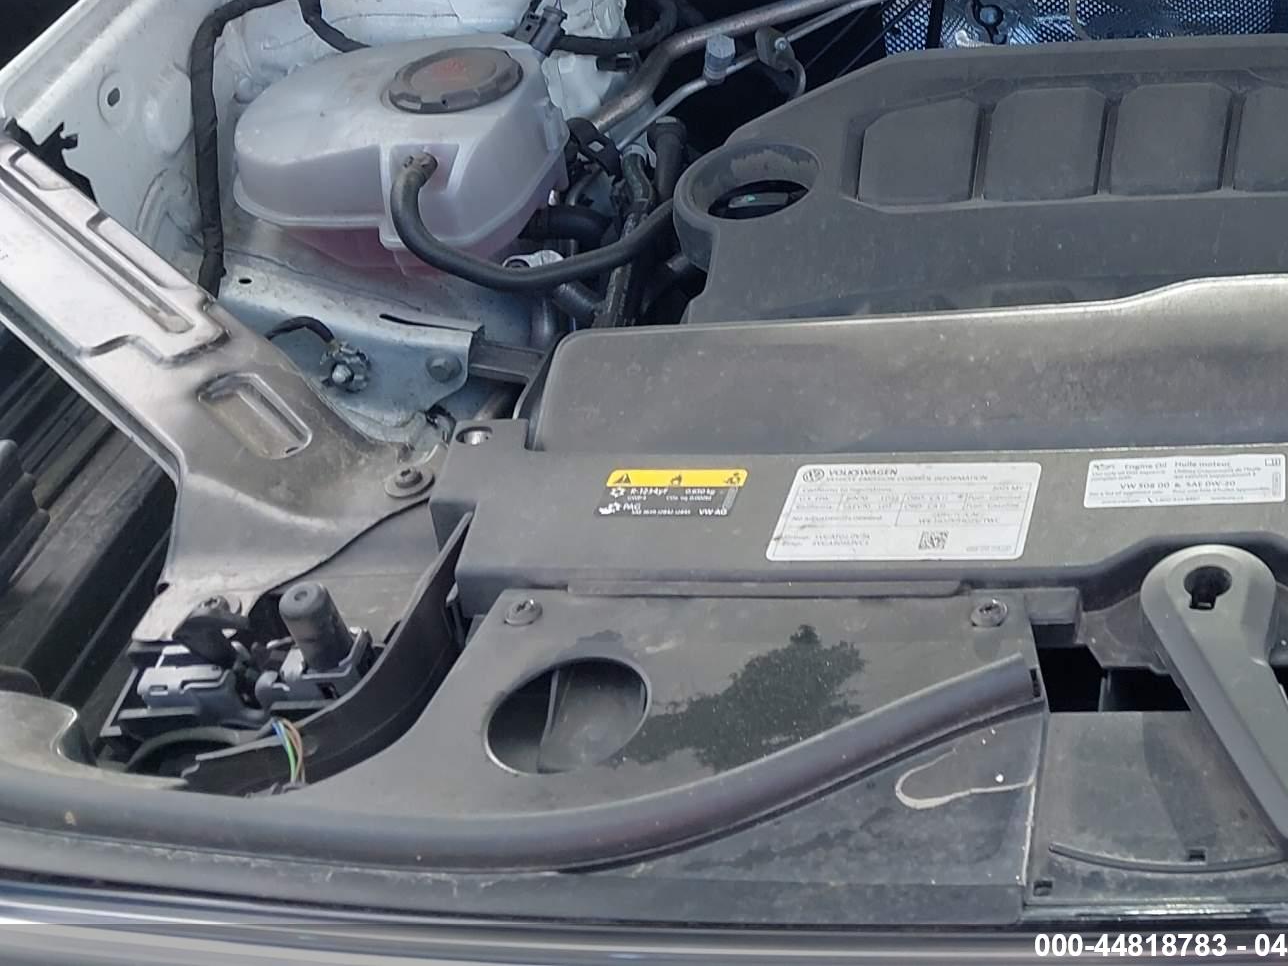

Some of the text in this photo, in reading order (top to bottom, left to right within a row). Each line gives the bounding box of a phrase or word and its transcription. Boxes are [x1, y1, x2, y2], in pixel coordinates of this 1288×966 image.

[1125, 464, 1154, 472] Engine
[1174, 459, 1197, 467] Huile
[1199, 459, 1231, 467] moteur
[828, 468, 898, 476] VOLKSWAGEN
[1120, 482, 1137, 490] VW
[699, 508, 714, 516] VW
